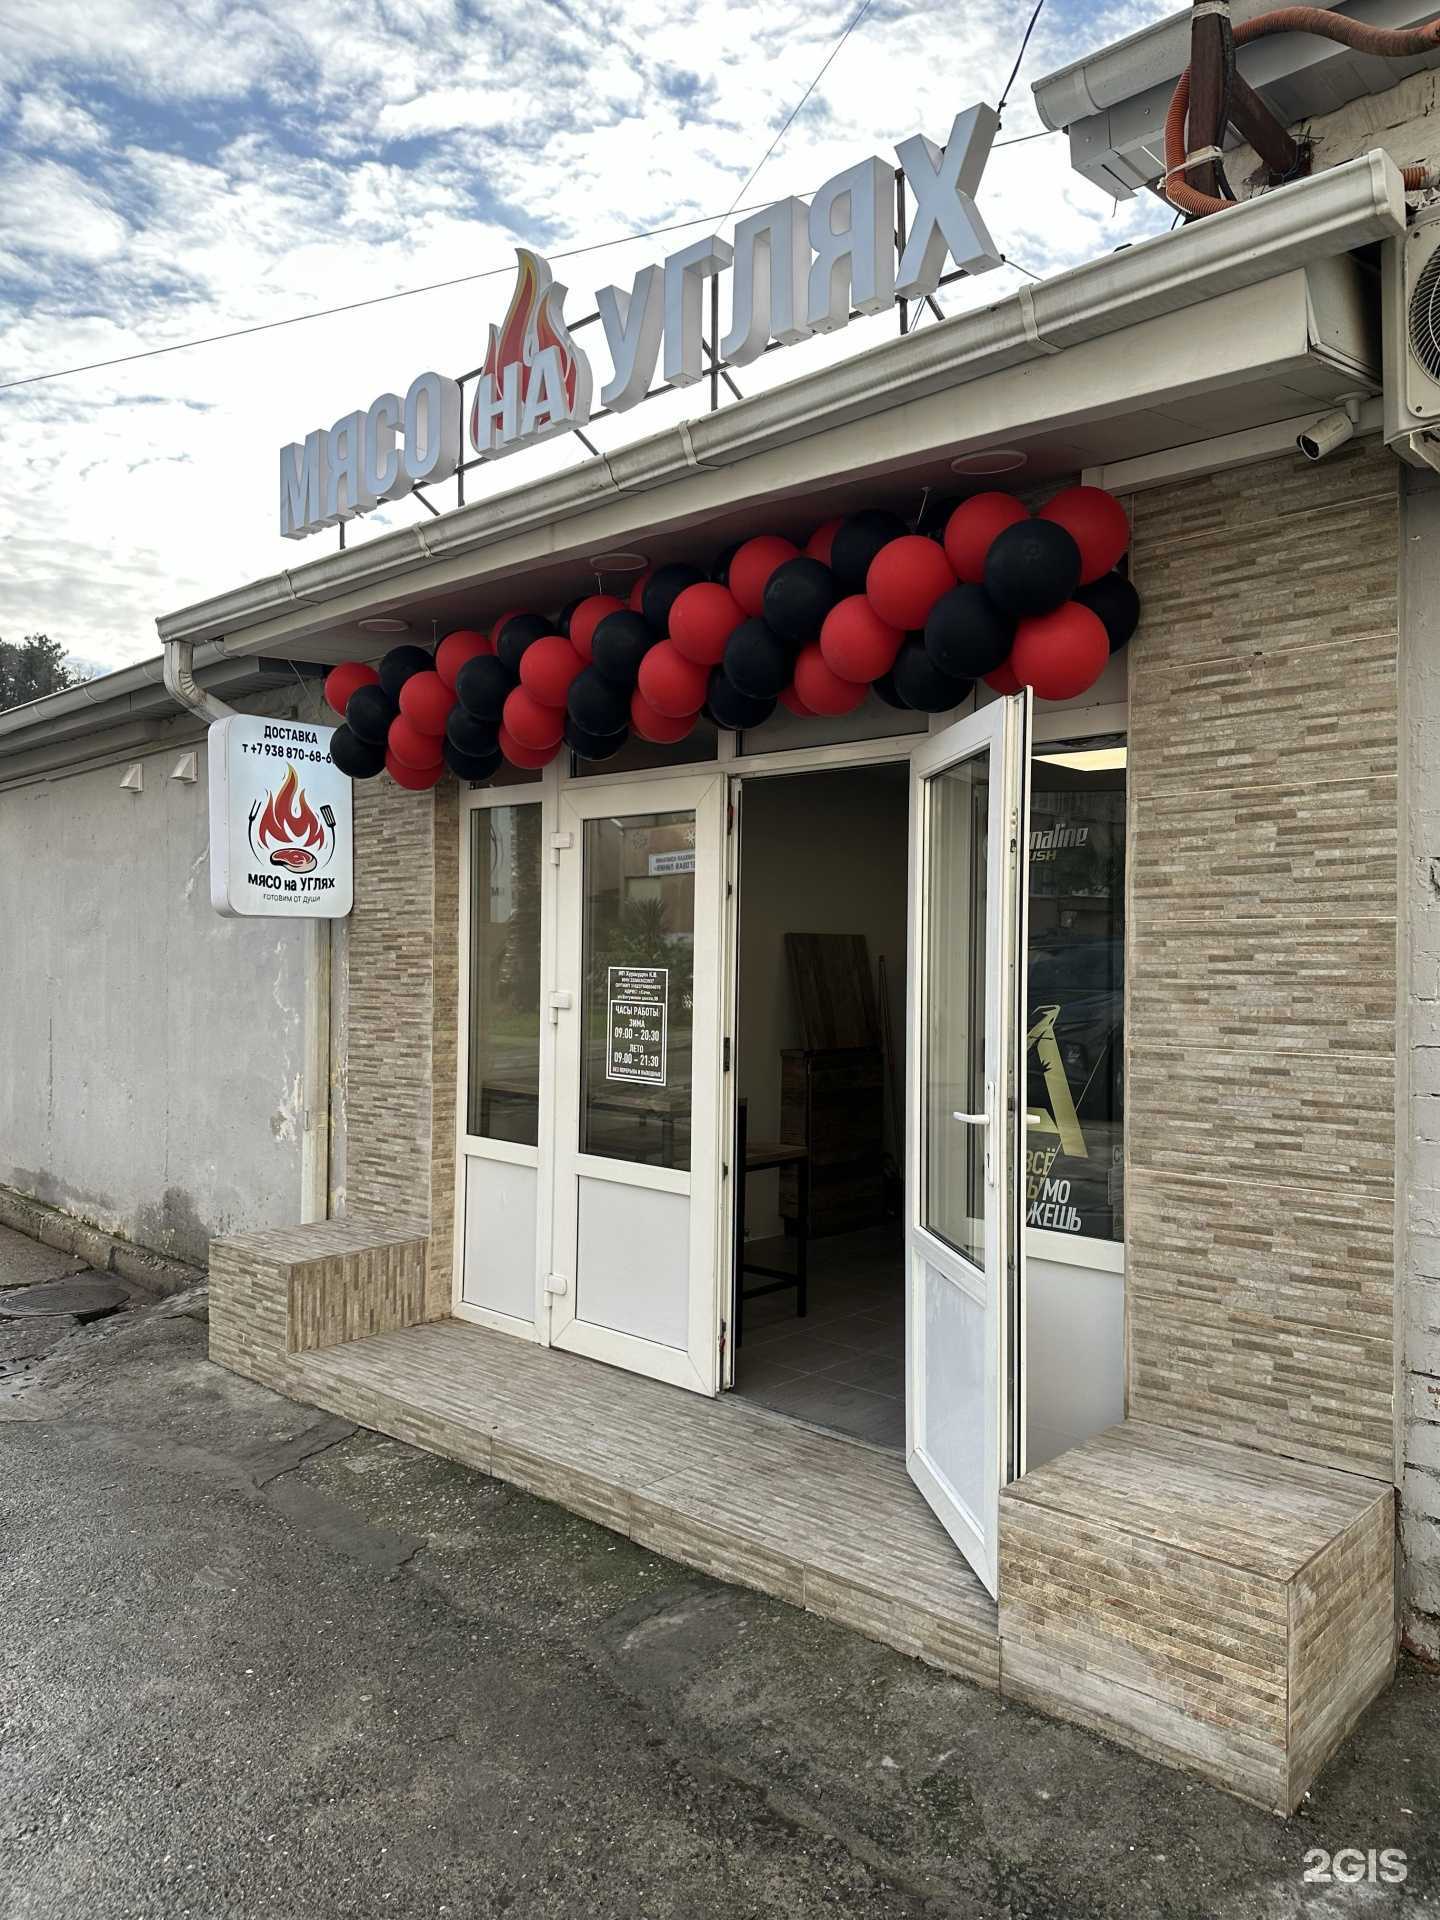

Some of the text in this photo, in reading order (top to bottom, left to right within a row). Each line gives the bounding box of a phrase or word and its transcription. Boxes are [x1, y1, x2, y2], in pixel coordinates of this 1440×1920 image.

[280, 102, 1004, 539] МЯСО НА УГЛЯХ
[264, 725, 318, 744] ДОСТАВКА
[251, 743, 263, 755] +7
[264, 744, 284, 758] 938
[286, 747, 335, 764] 870-68-6
[1029, 823, 1088, 850] naline
[248, 873, 336, 891] МЯСО на УГЛЯХ
[615, 1005, 659, 1017] ЧАСЫ РАБОТЫ
[629, 1018, 645, 1028] ЗИМА
[614, 1027, 633, 1039] 09:00
[640, 1029, 660, 1042] 20:30
[629, 1043, 644, 1053] ЛЕТО
[614, 1051, 632, 1064] 09:00
[640, 1054, 659, 1067] 21:30
[1042, 1178, 1071, 1204] МО
